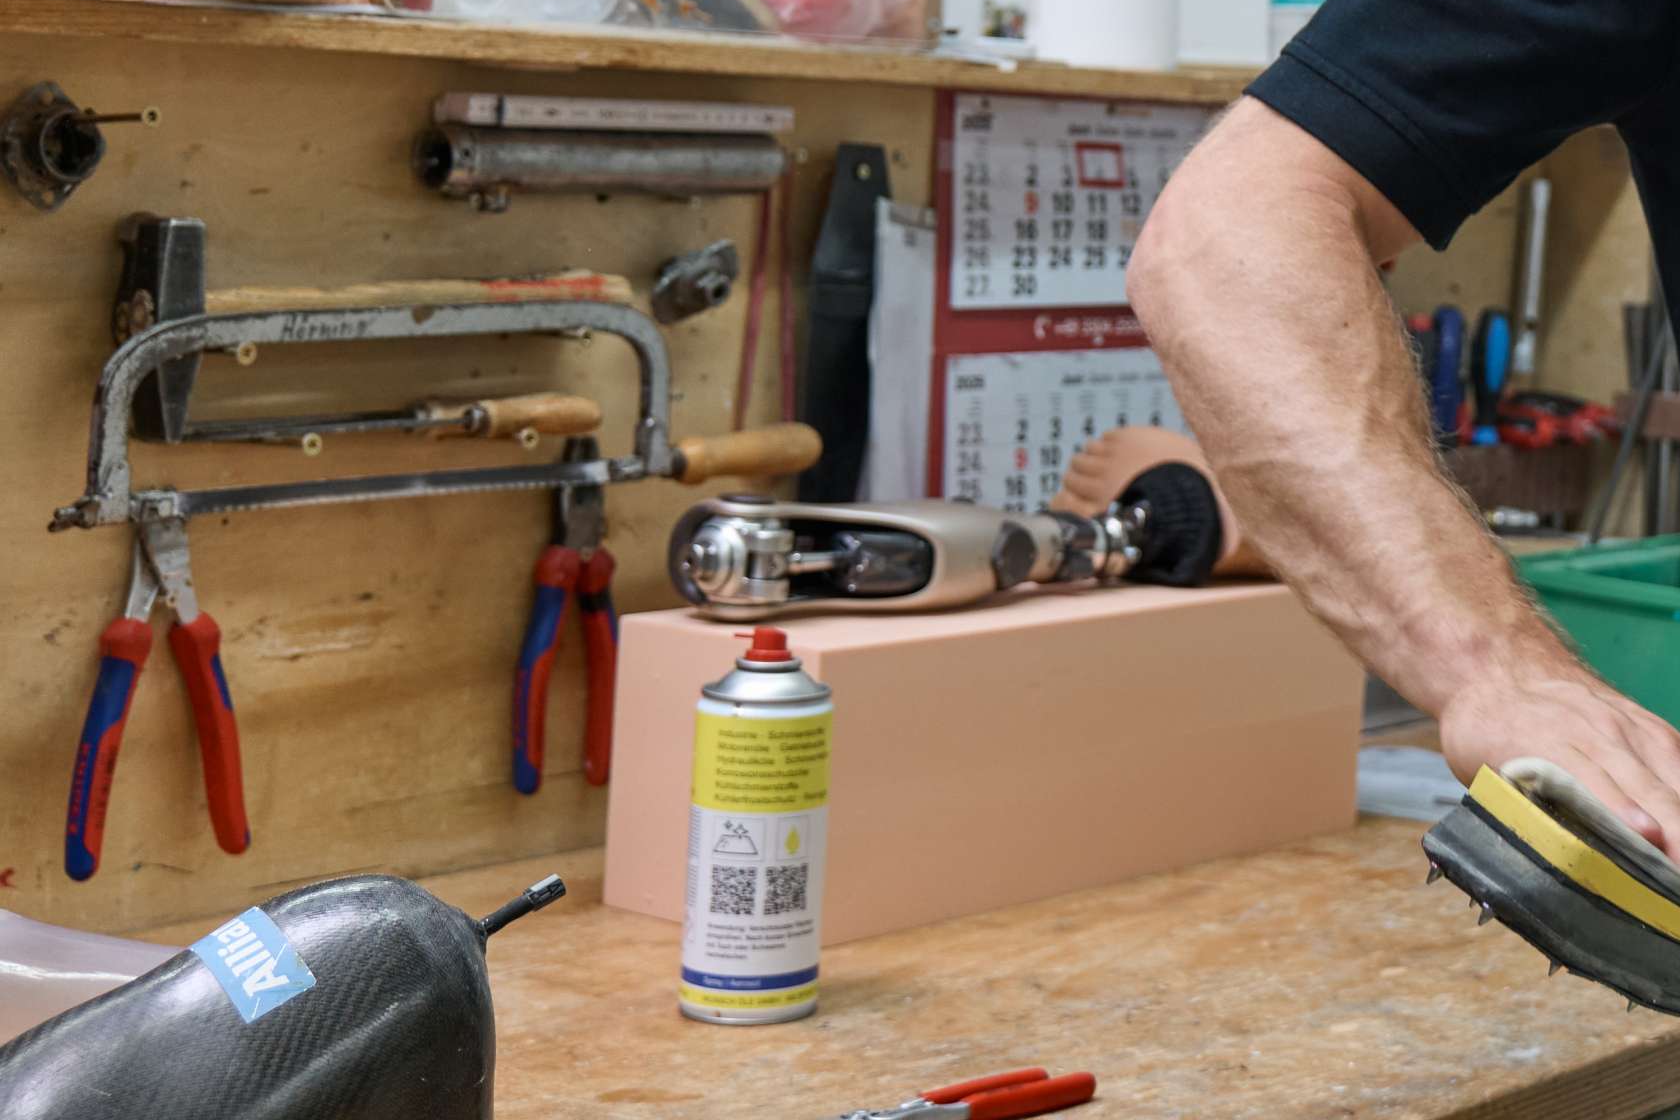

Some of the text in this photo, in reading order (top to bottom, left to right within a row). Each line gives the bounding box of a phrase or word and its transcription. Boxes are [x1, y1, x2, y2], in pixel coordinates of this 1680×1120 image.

[1052, 192, 1074, 215] 10
[1087, 192, 1108, 215] 11
[1121, 192, 1142, 215] 12
[1015, 219, 1039, 242] 16
[1052, 219, 1074, 242] 17
[1087, 220, 1109, 242] 18
[1013, 246, 1037, 269] 23
[1049, 246, 1072, 269] 24
[1084, 246, 1106, 269] 25
[1013, 274, 1037, 297] 30
